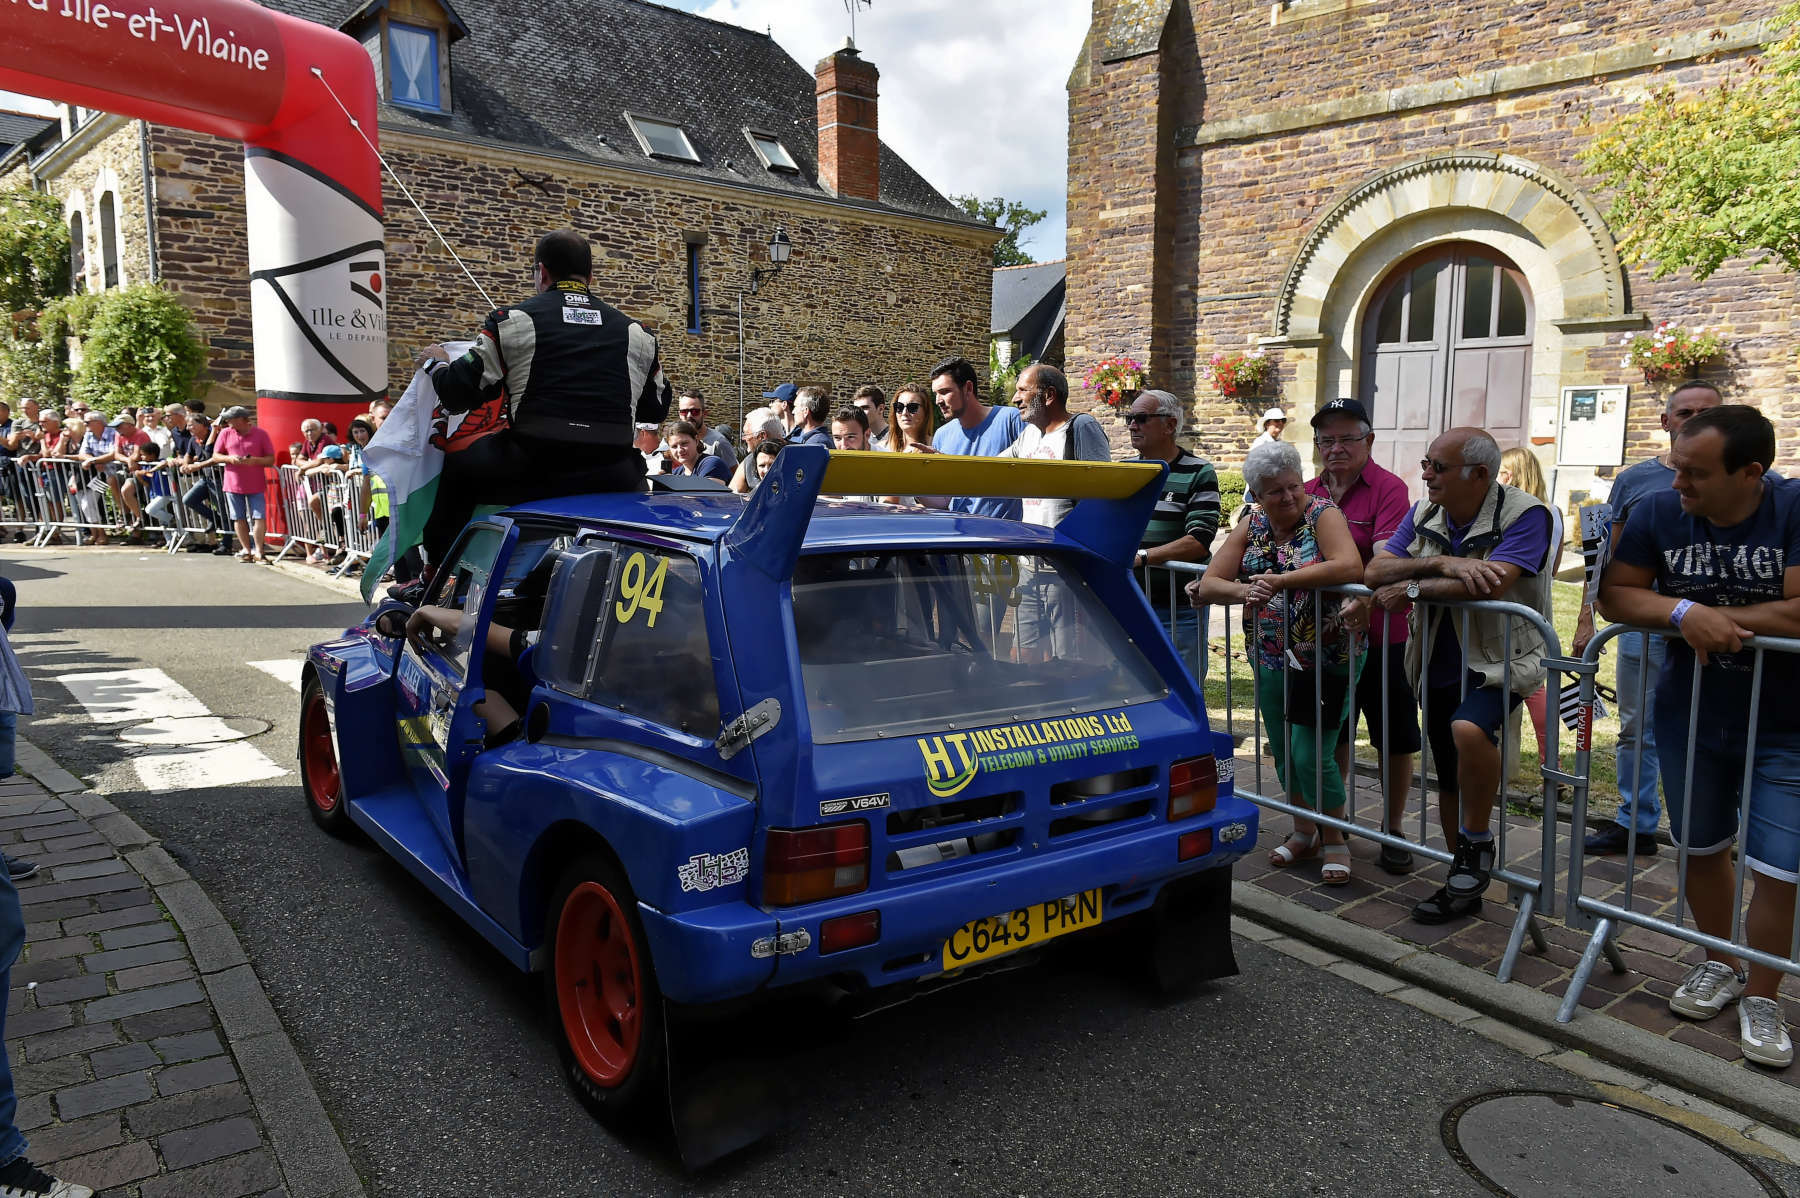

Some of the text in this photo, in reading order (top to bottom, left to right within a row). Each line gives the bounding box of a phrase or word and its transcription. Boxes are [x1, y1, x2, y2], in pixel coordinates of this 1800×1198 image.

[312, 307, 386, 331] Ille & Vil
[616, 552, 671, 628] 94
[968, 711, 1134, 754] INSTALLATIONS Ltd
[1577, 707, 1587, 751] ALTRAD
[917, 732, 973, 781] HT
[978, 734, 1140, 773] TELECOM & UTILITY SERVICES
[851, 796, 885, 809] V64V
[948, 887, 1098, 961] C643 PRN
